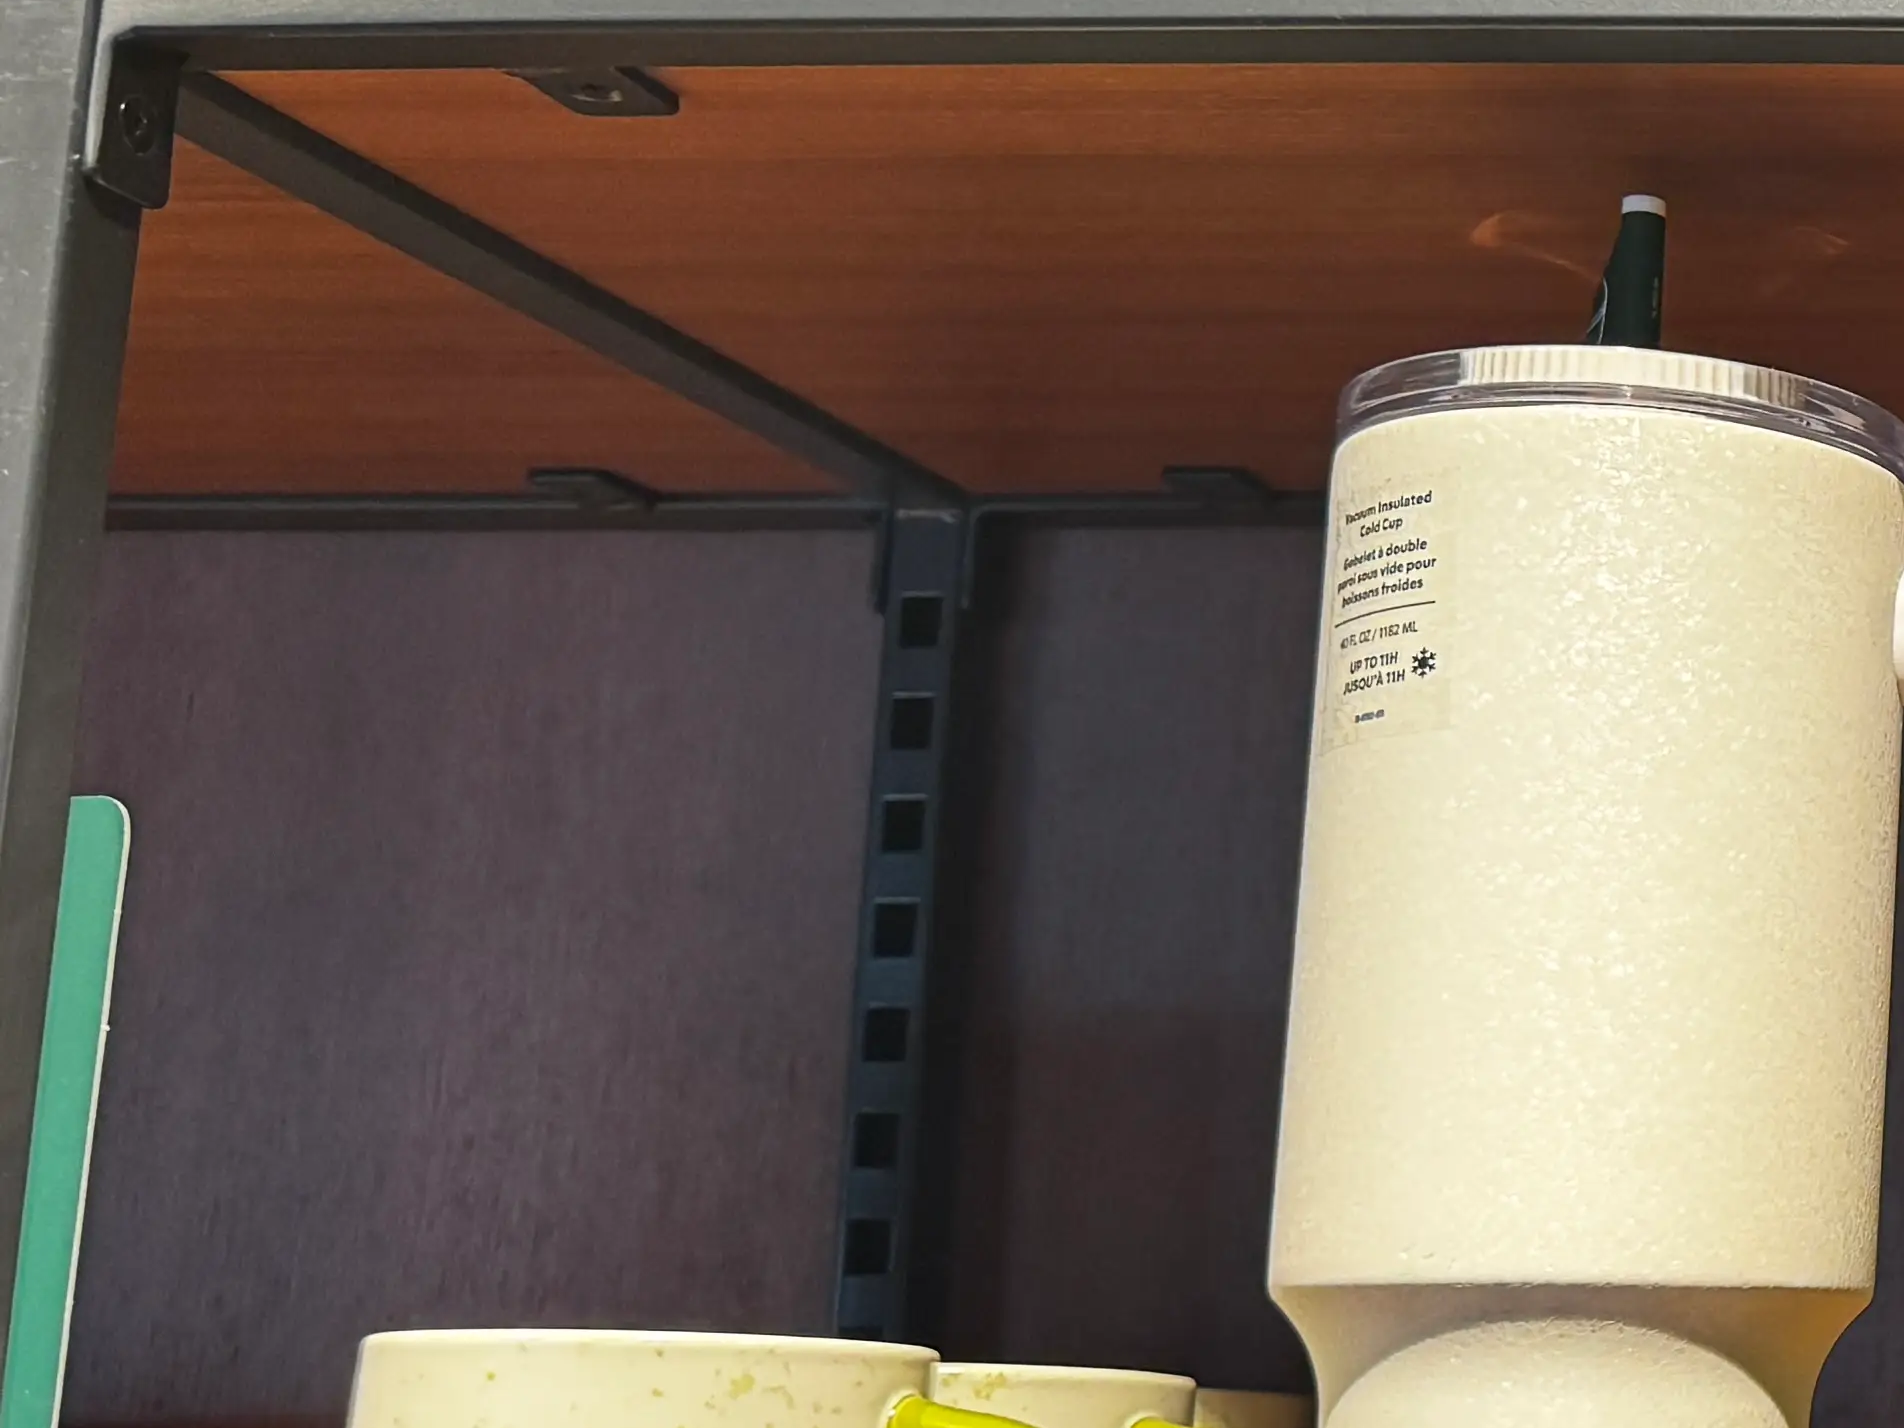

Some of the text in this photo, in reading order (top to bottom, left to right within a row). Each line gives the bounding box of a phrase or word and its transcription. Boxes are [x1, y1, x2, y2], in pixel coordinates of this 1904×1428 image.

[1378, 490, 1432, 515] Insulated
[1360, 517, 1403, 537] Cold Cup
[1377, 546, 1384, 559] à
[1386, 538, 1427, 556] double
[1380, 562, 1404, 577] vide
[1406, 557, 1437, 574] pour
[1381, 577, 1424, 596] froides
[1379, 624, 1400, 640] 1182
[1402, 620, 1418, 635] ML
[1350, 650, 1398, 674] UP TO 11H
[1386, 668, 1405, 684] 11H
